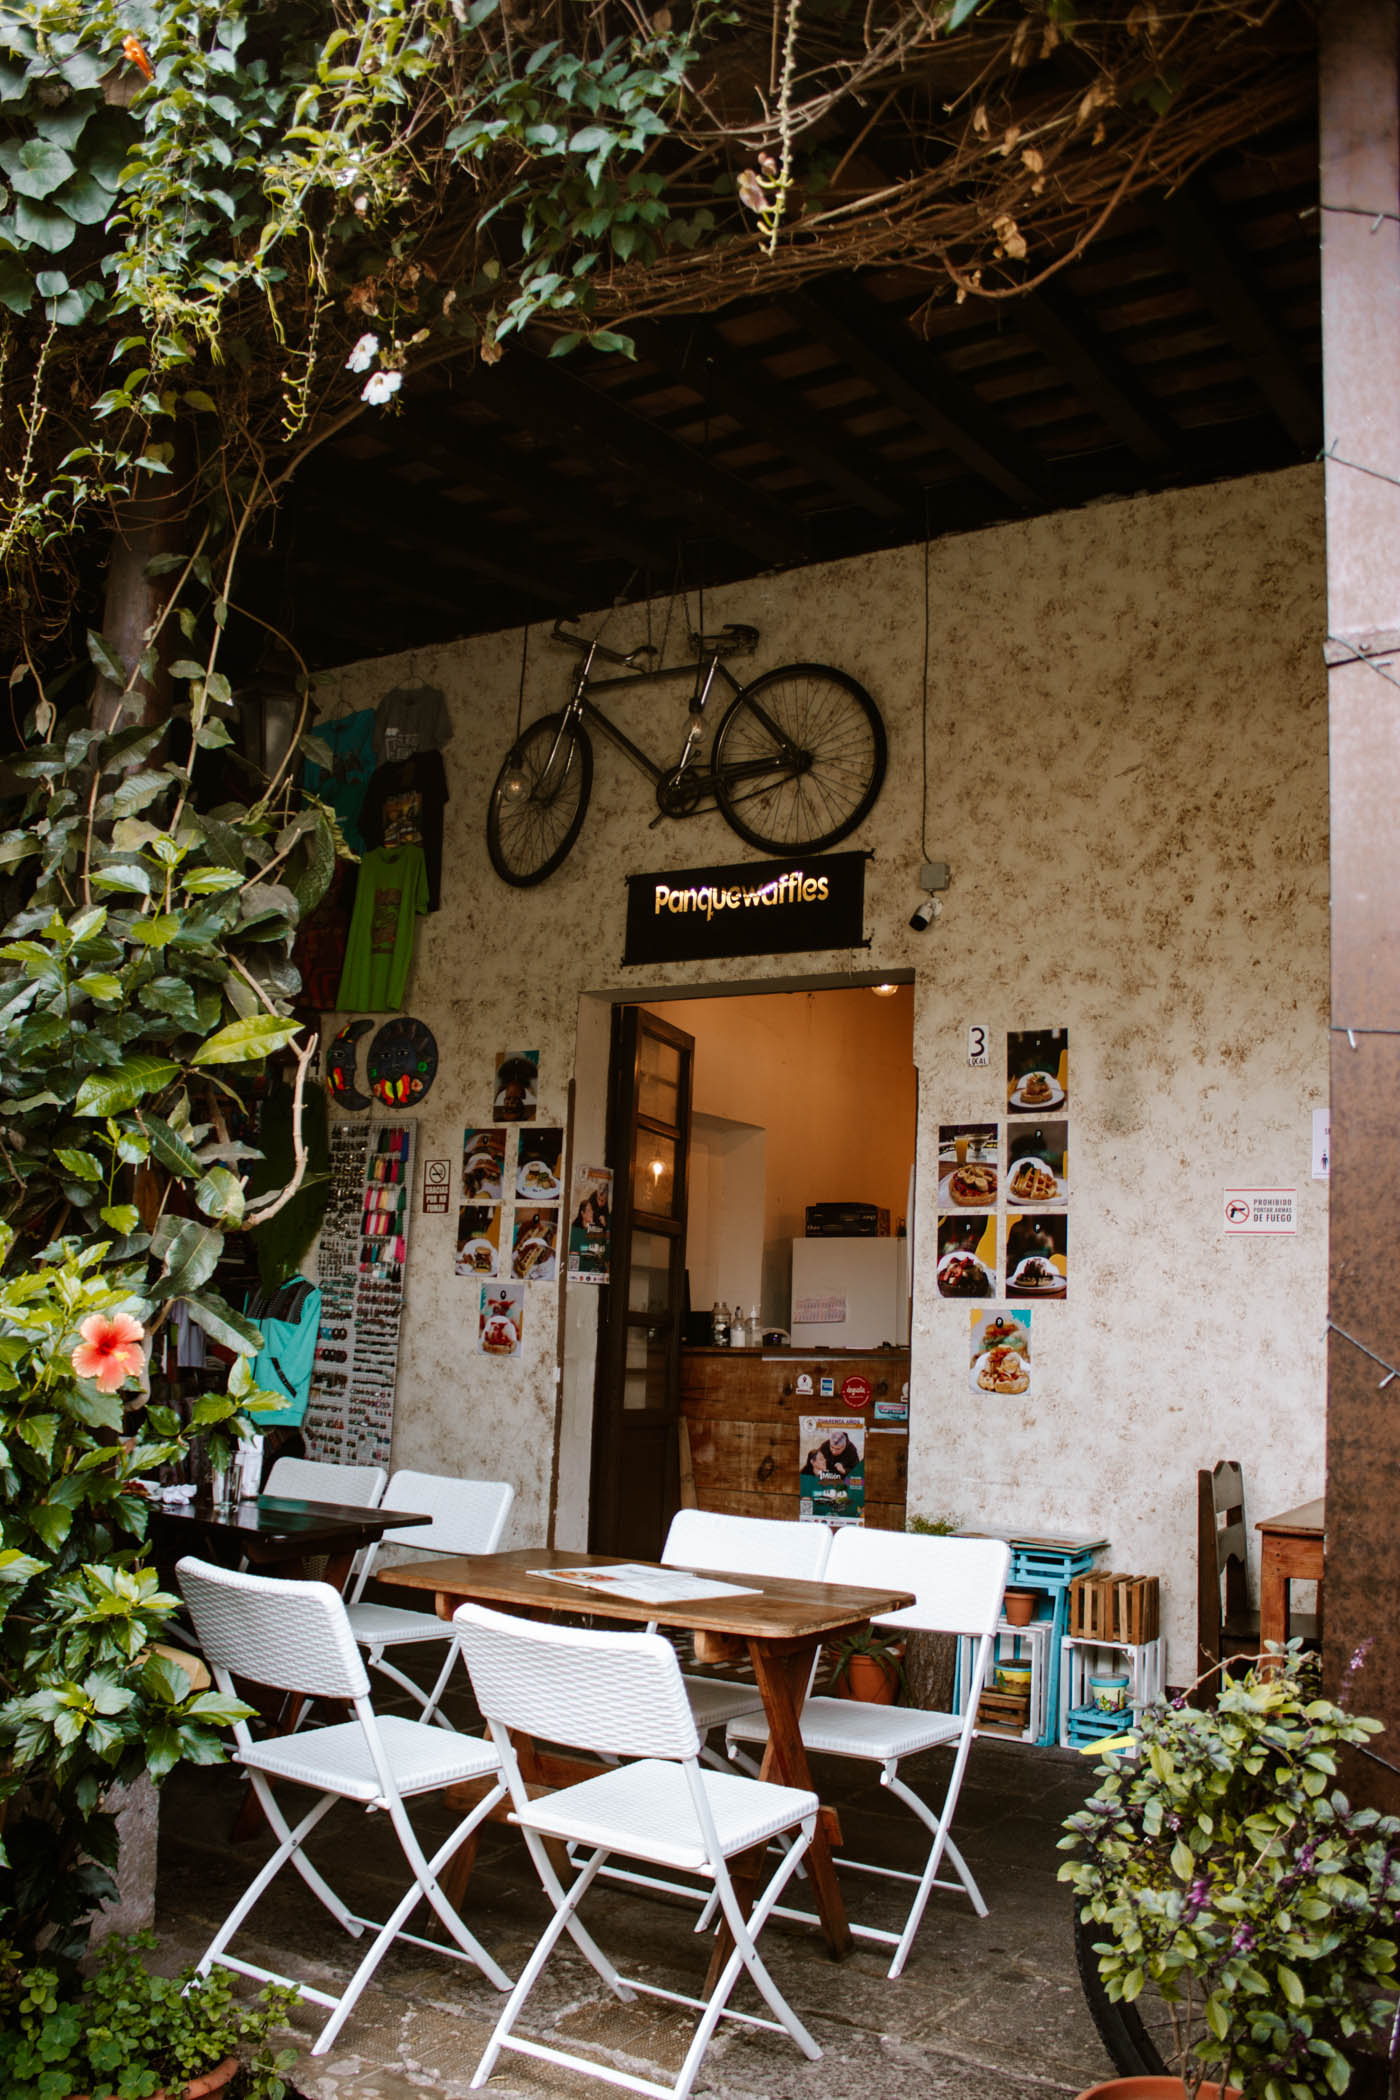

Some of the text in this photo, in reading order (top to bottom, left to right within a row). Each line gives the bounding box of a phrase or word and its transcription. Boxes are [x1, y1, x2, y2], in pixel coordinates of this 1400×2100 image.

[654, 870, 830, 922] Panquewaffles
[970, 1026, 985, 1057] 3
[968, 1057, 987, 1067] LOCAL
[1253, 1214, 1292, 1222] DE FUEGO
